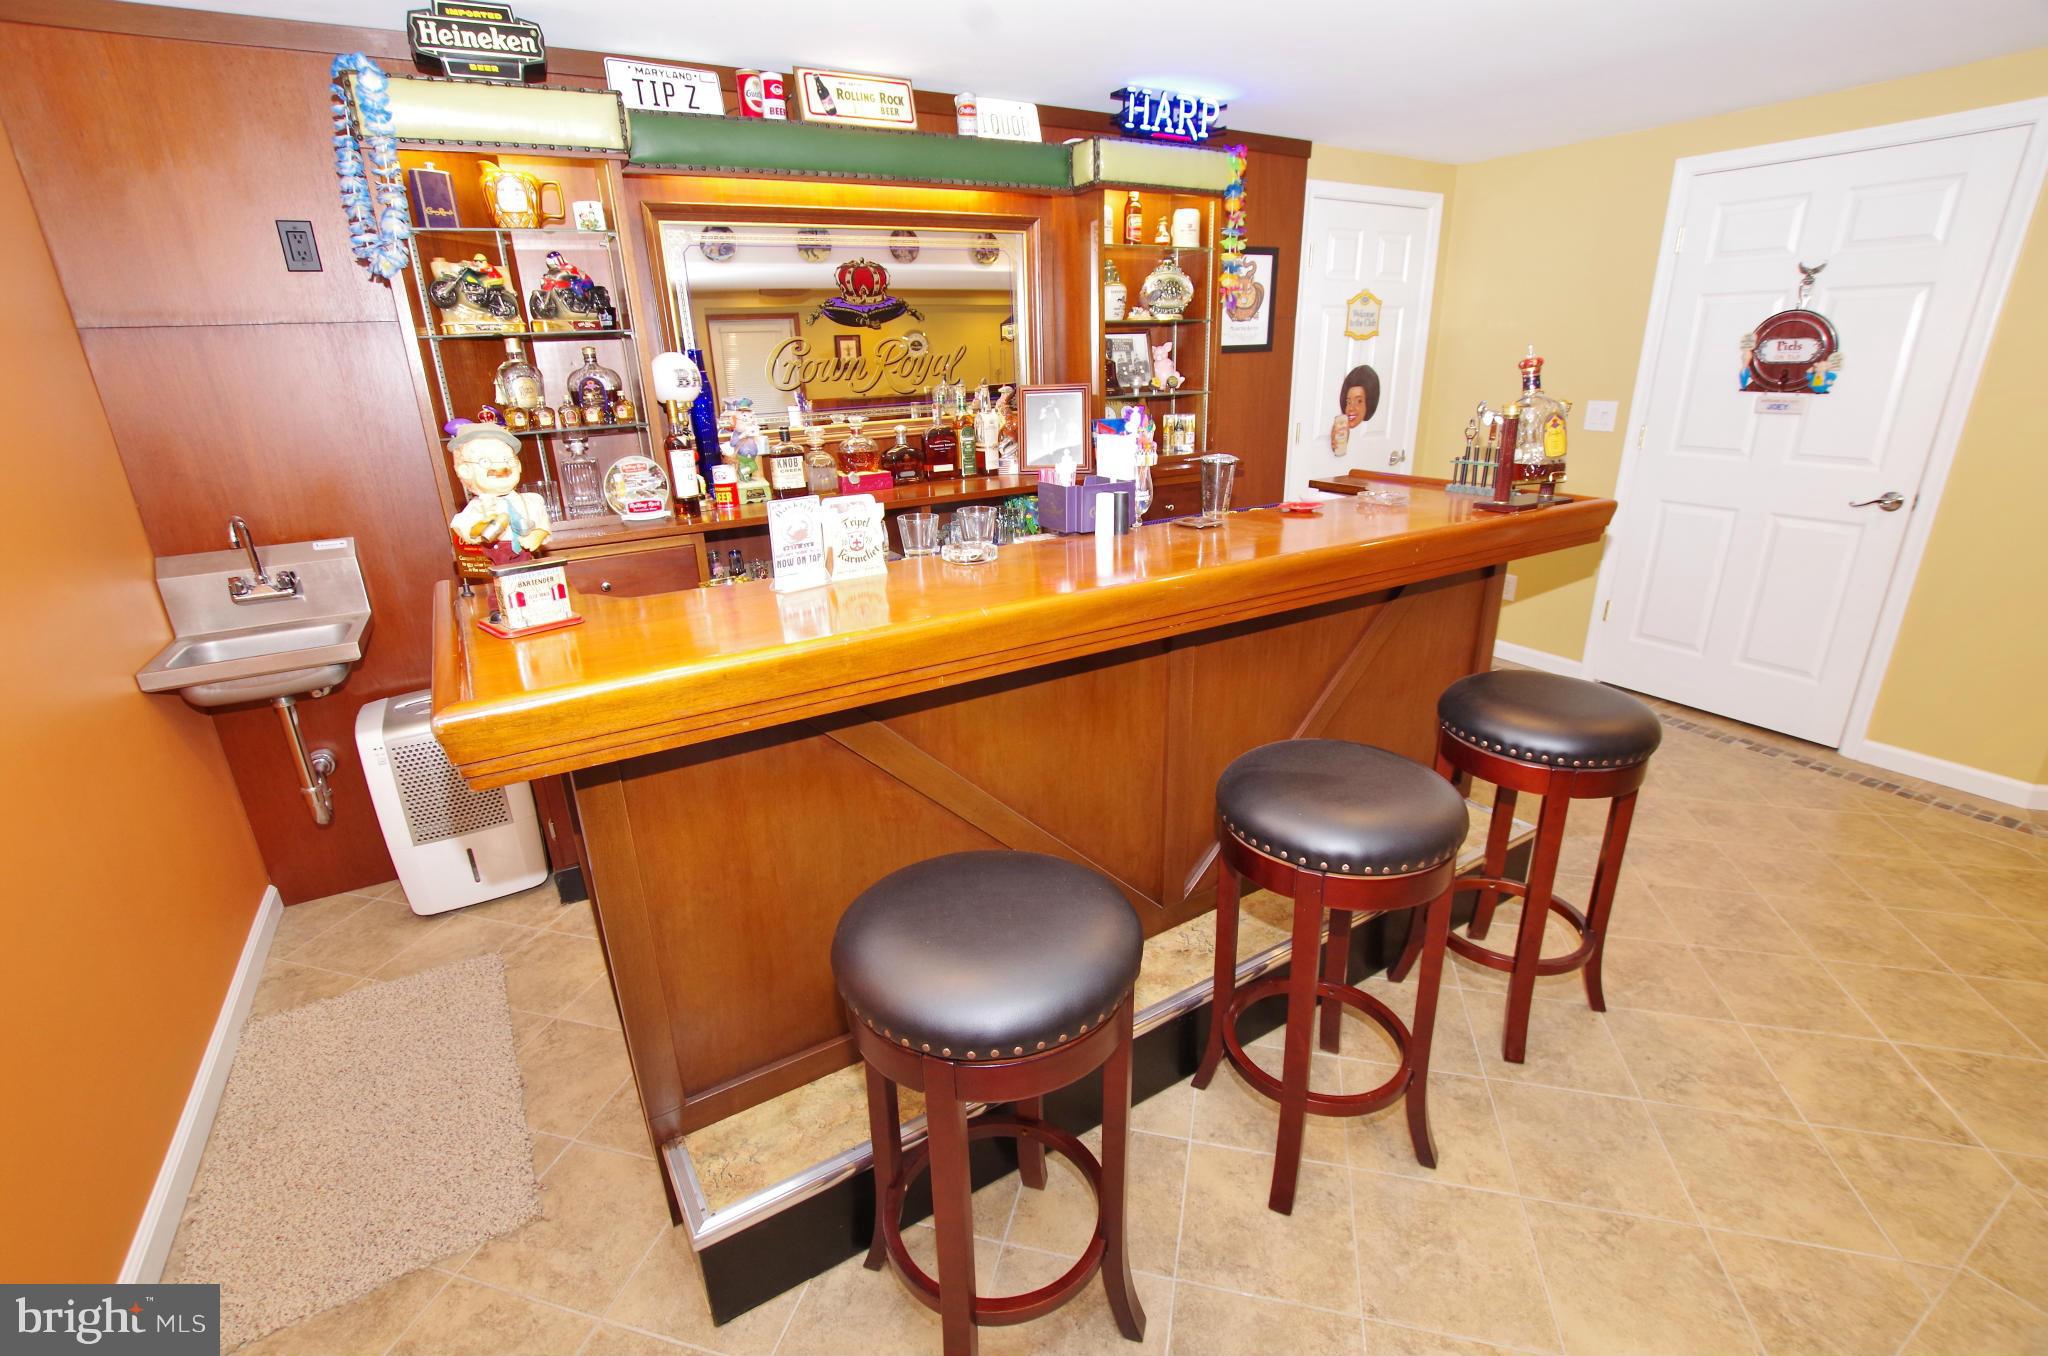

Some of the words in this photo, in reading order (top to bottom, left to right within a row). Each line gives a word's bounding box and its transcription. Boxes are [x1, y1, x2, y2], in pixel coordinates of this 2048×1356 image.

[445, 7, 503, 20] IMPORTED
[416, 20, 538, 53] Heineken
[469, 63, 499, 73] BEER
[634, 67, 692, 81] MARYLAND
[632, 78, 675, 107] TIP
[684, 84, 700, 110] Z
[880, 107, 900, 116] BEER
[1124, 86, 1220, 141] HARP
[764, 336, 868, 391] Crown
[851, 336, 967, 394] Royal
[776, 457, 799, 470] KNOB
[776, 557, 794, 569] NOW
[796, 554, 807, 566] ON
[517, 576, 554, 588] BARTENDER
